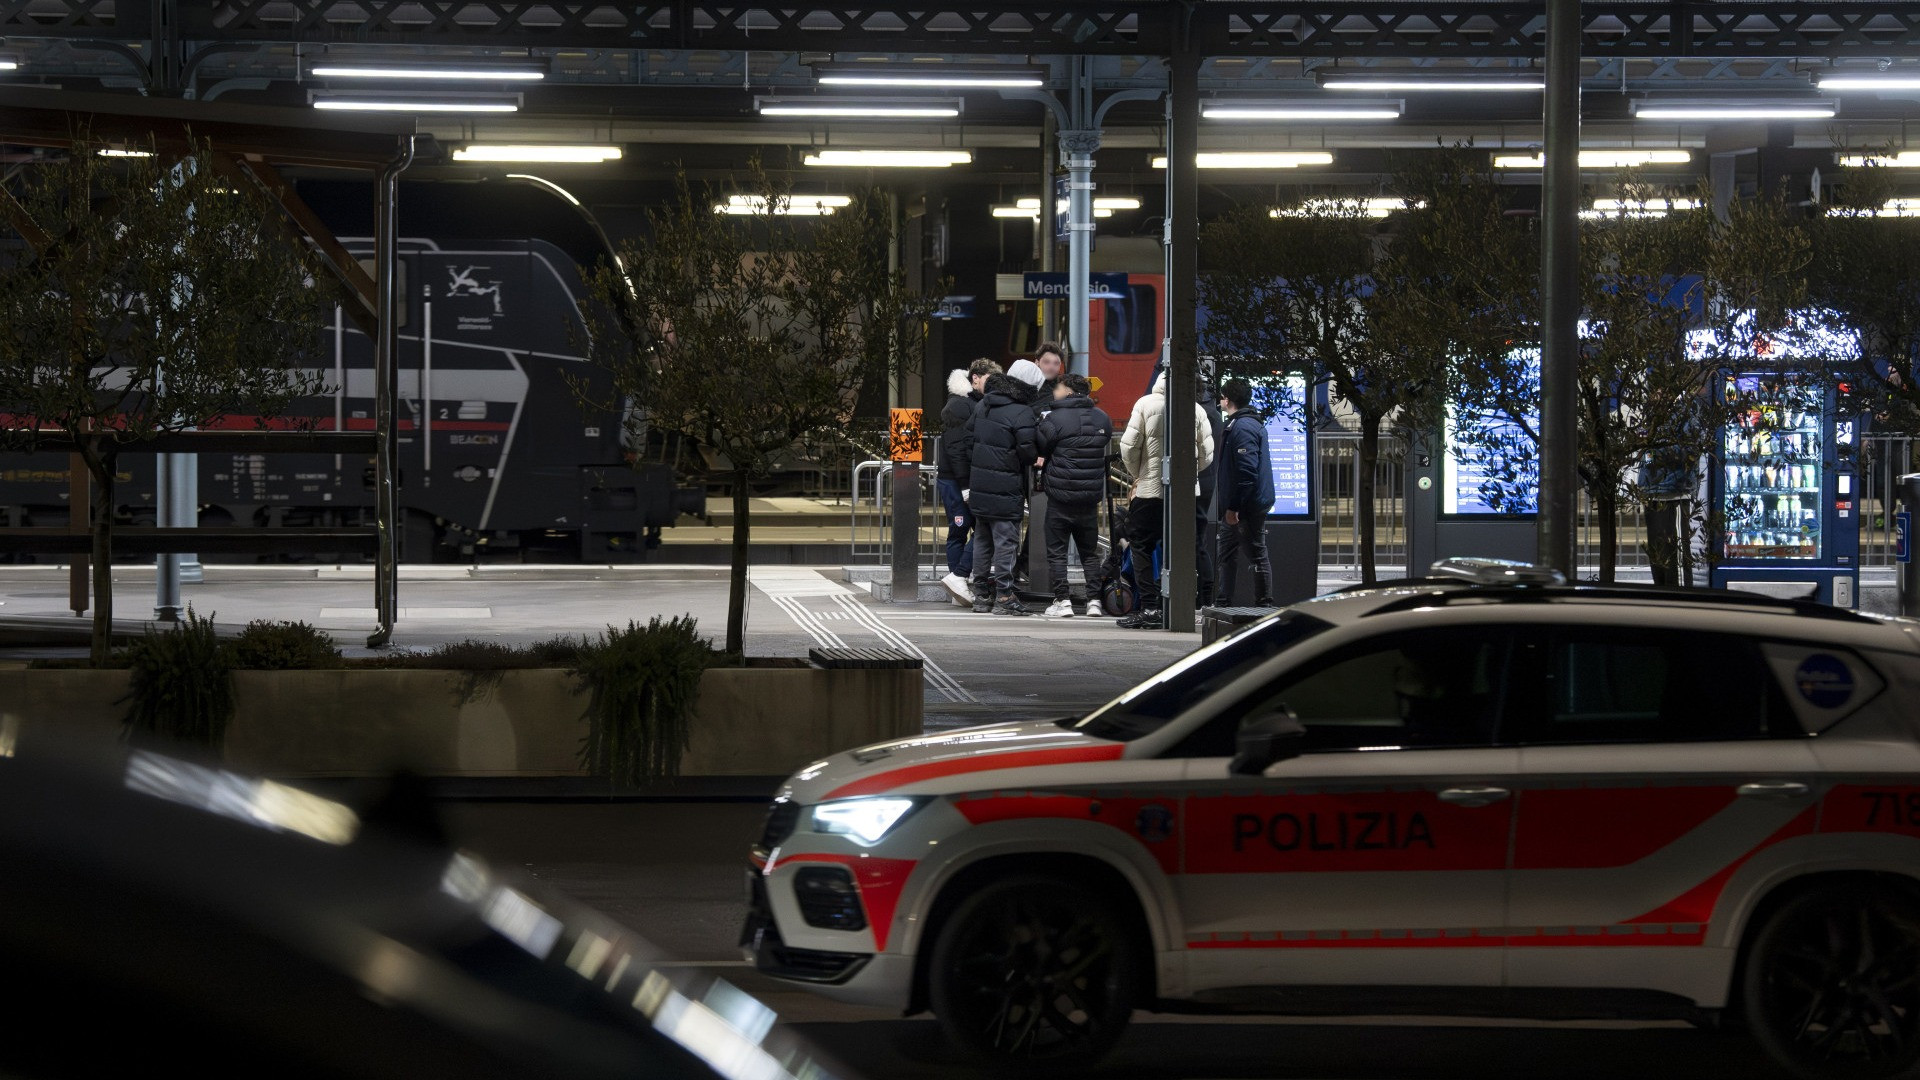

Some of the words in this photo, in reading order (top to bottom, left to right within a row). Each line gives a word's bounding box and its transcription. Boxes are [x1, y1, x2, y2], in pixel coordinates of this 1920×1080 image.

[440, 408, 449, 419] 2
[450, 434, 498, 445] BEACON
[1232, 812, 1436, 851] POLIZIA
